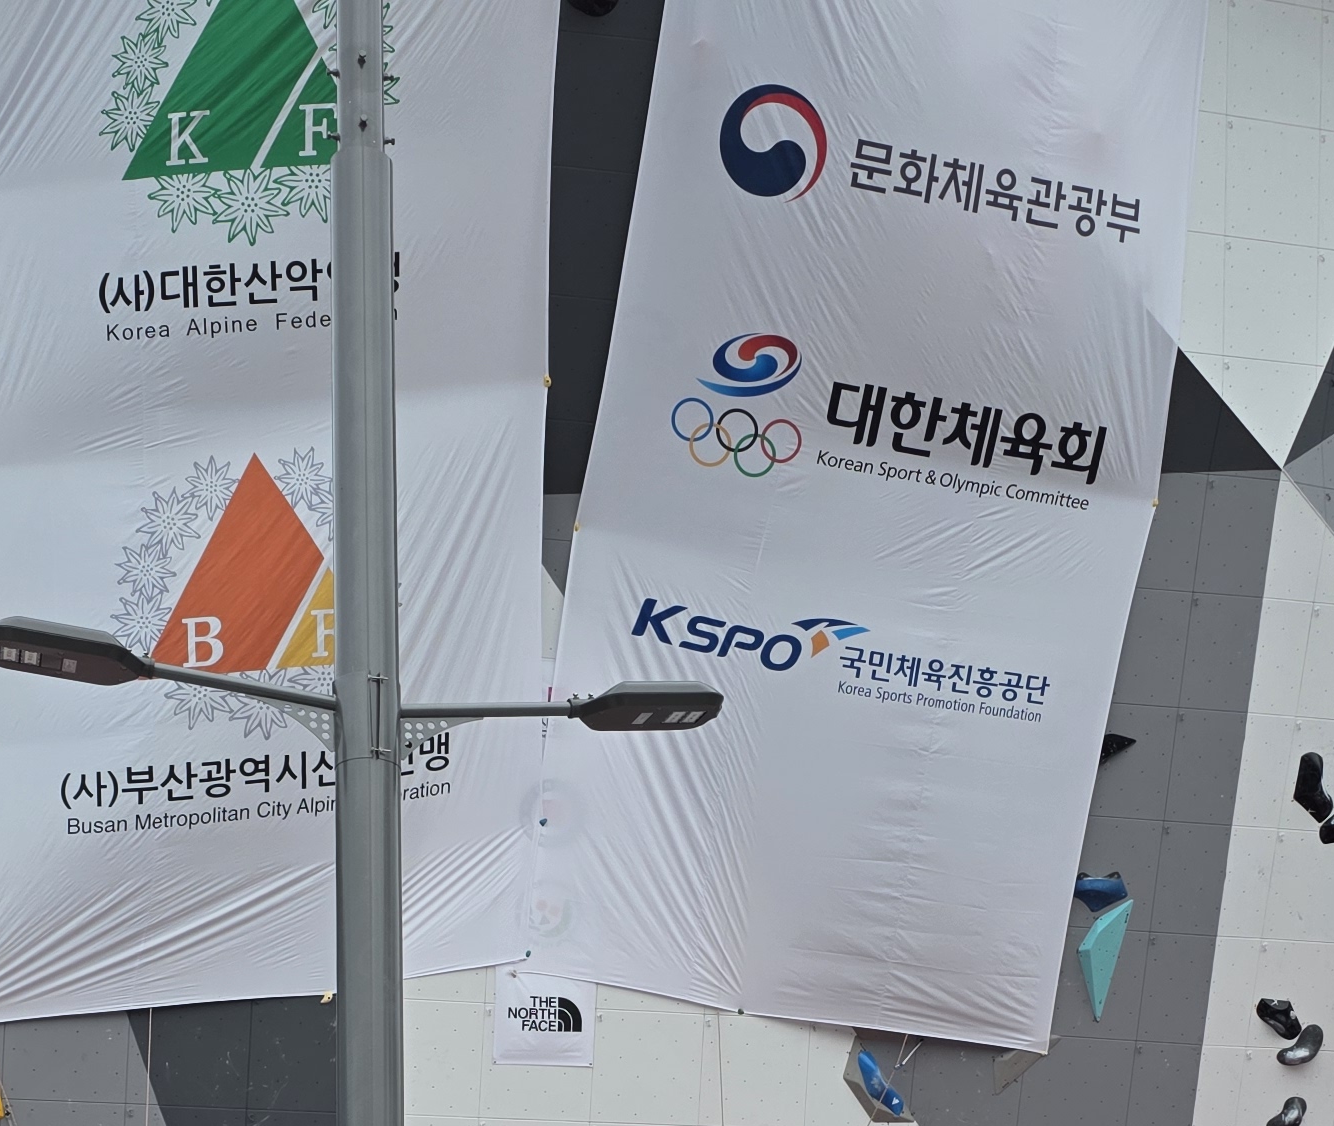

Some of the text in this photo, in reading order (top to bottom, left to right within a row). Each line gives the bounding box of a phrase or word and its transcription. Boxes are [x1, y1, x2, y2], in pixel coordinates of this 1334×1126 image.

[166, 110, 210, 166] K
[849, 138, 1142, 243] 문화체육관광부
[98, 251, 400, 313] (사)대한산악
[106, 321, 170, 342] Korea
[186, 315, 258, 339] Alpine
[826, 381, 1108, 485] 대한체육회
[816, 450, 1090, 512] Korean Sport & Olympic Committee
[182, 616, 224, 668] B
[631, 598, 802, 672] KSPO
[837, 680, 1043, 723] Korea Sports Promotion Foundation
[839, 646, 1051, 706] 국민체육진흥공단
[60, 731, 450, 810] (사)부산광역시산맹
[67, 817, 128, 836] Busan
[135, 804, 250, 834] Metropolitan
[256, 799, 292, 822] City
[296, 796, 335, 817] Alpi
[508, 1007, 556, 1019] NORTH
[522, 1020, 556, 1031] FACE
[530, 996, 556, 1008] THE
